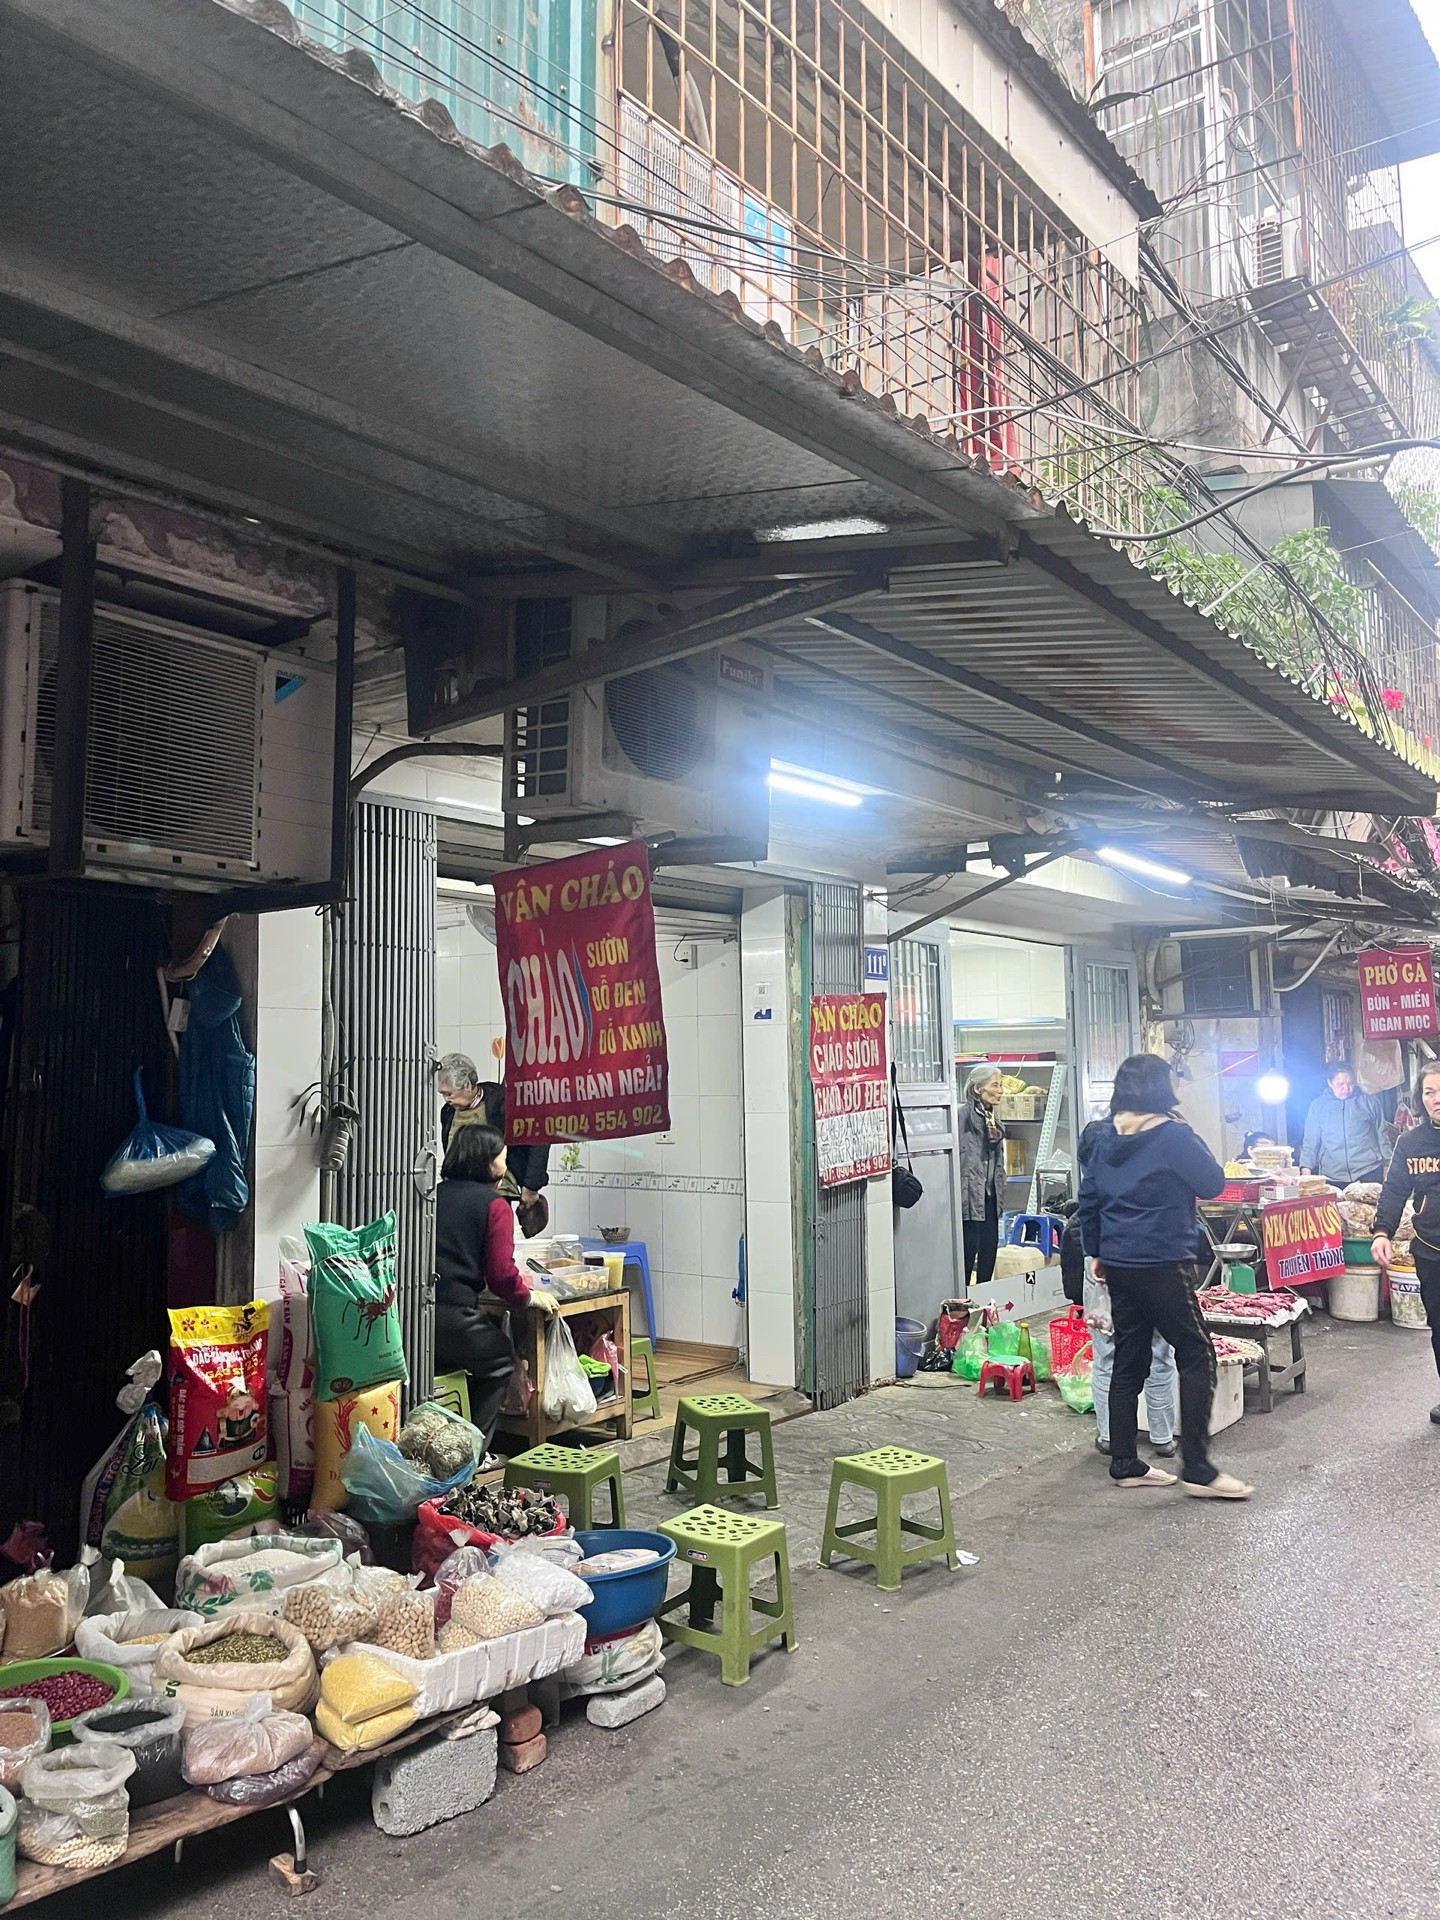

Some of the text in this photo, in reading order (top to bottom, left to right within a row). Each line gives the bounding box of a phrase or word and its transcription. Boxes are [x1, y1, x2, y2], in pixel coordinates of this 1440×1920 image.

[500, 860, 645, 925] VÂN CHÁO
[586, 933, 629, 968] SƯỜN
[1364, 956, 1427, 986] PHỞ GÀ
[507, 928, 584, 1068] CHÁO
[614, 978, 646, 1008] ĐEN
[1367, 993, 1391, 1011] BÚN
[840, 996, 882, 1031] CHÁO
[1370, 1014, 1431, 1032] NGAN MỌC
[618, 1021, 663, 1052] XANH
[513, 1071, 572, 1107] TRỨNG
[575, 1068, 614, 1102] RÁN
[545, 1114, 589, 1136] 0904
[595, 1109, 628, 1131] 554
[632, 1104, 664, 1127] 902
[856, 1159, 871, 1174] 554
[873, 1155, 888, 1170] 902
